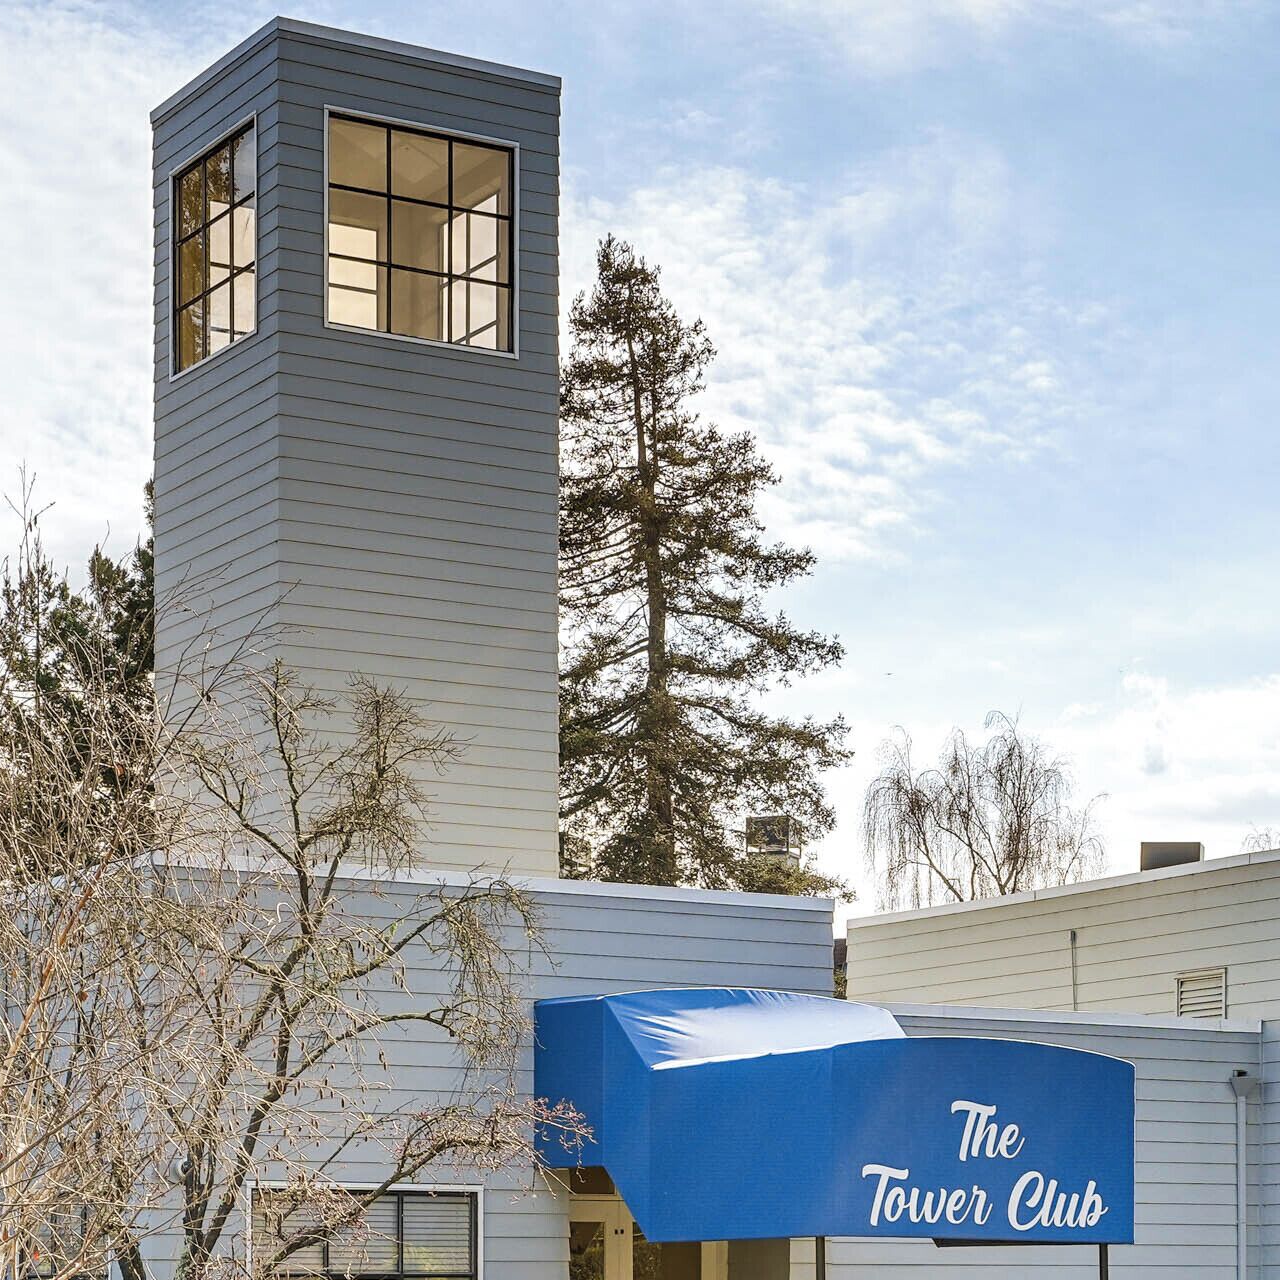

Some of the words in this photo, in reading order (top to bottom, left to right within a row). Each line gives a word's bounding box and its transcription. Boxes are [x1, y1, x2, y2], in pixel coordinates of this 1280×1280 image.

[951, 1100, 1025, 1162] The
[861, 1163, 993, 1227] Tower
[1007, 1170, 1109, 1231] Club
